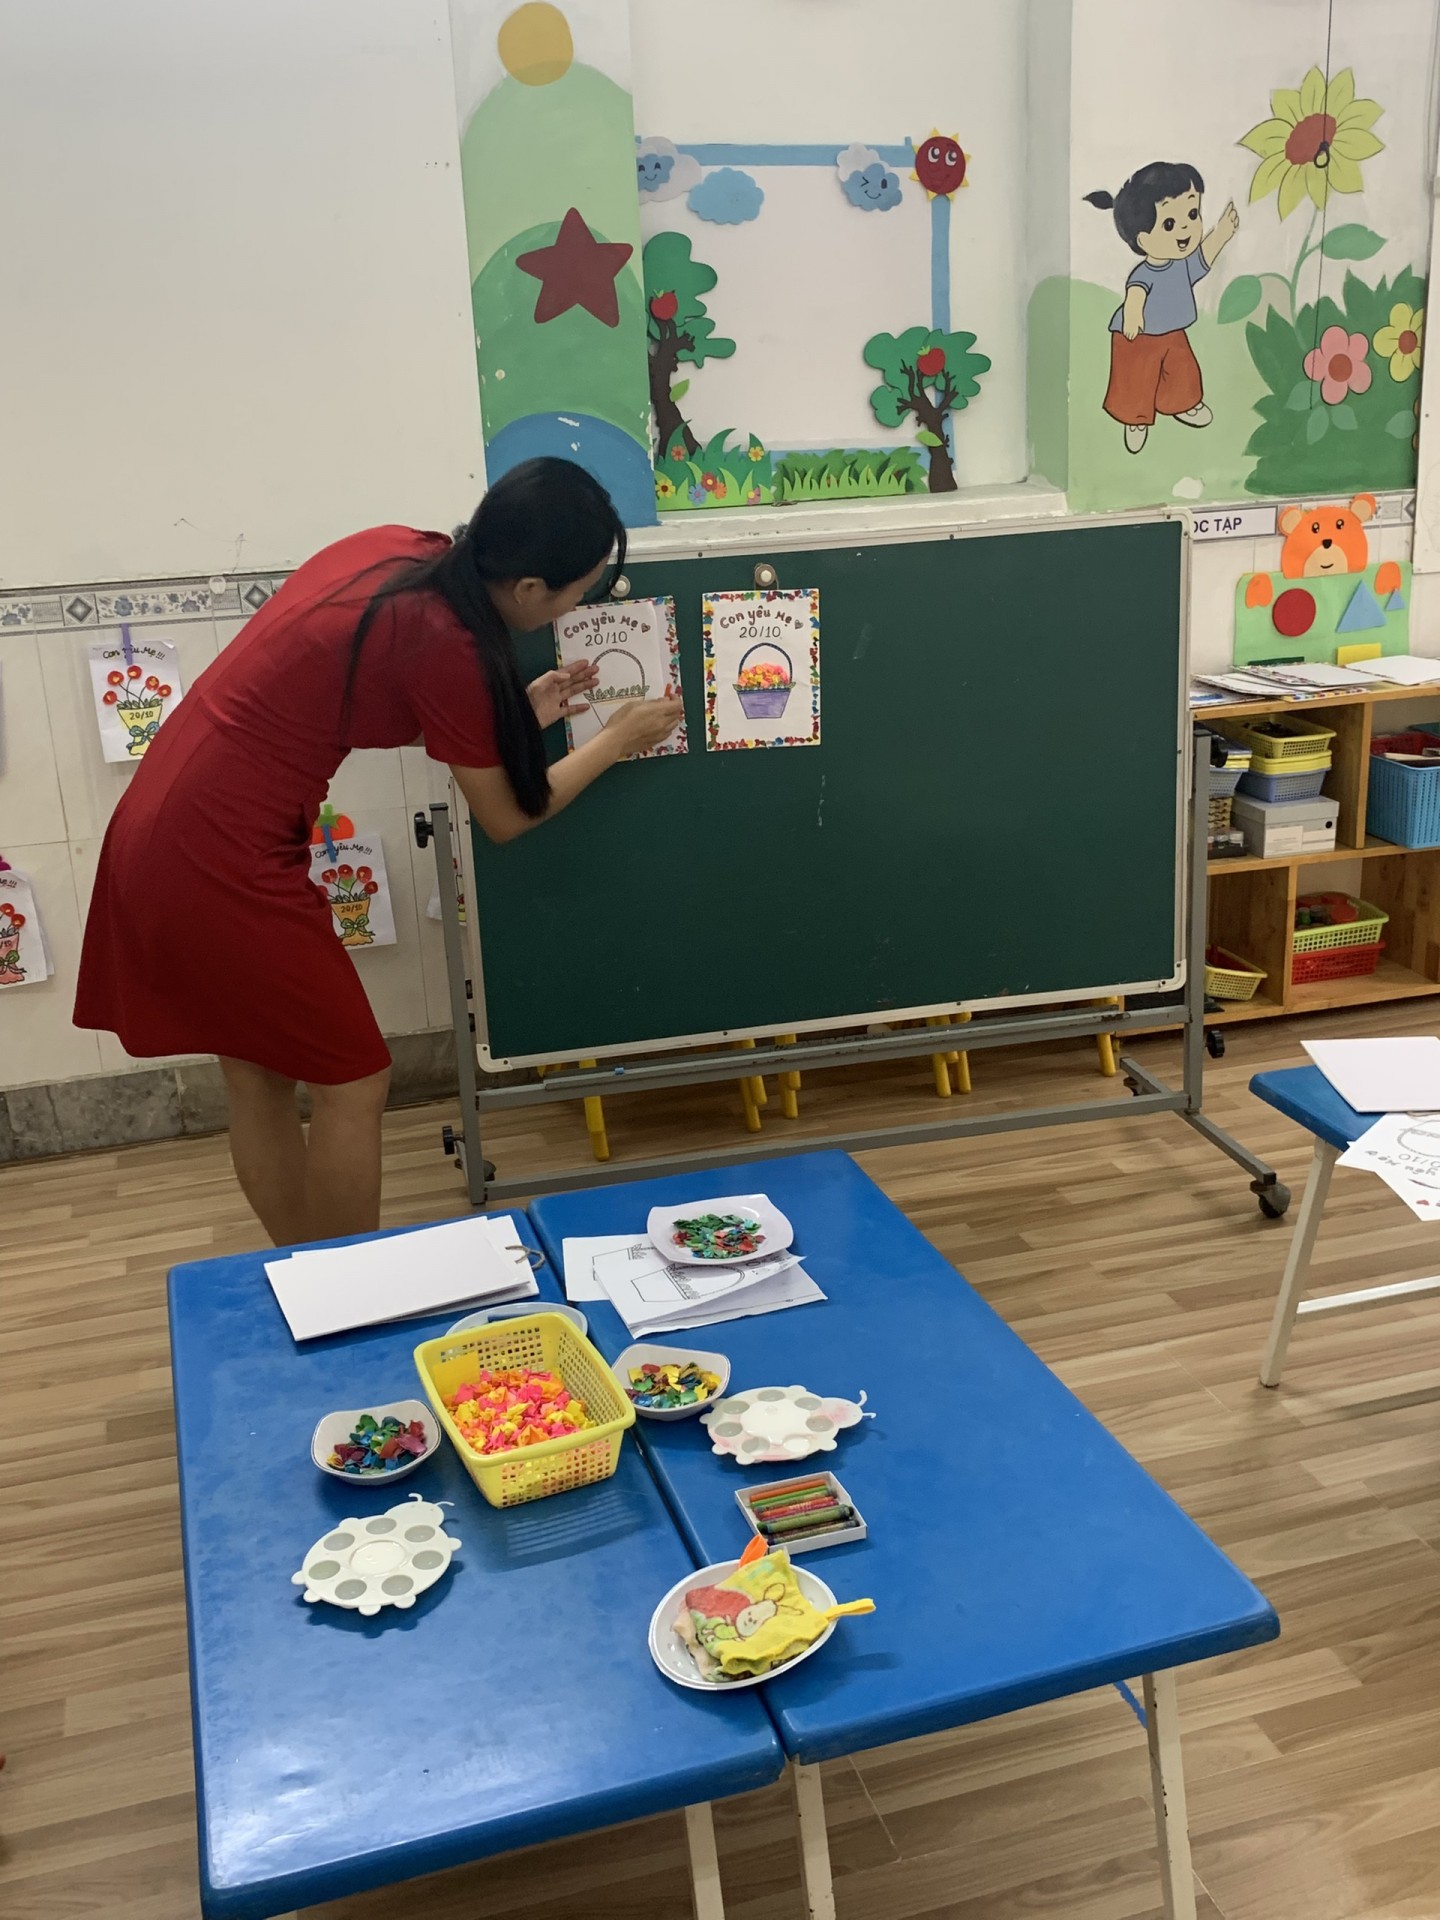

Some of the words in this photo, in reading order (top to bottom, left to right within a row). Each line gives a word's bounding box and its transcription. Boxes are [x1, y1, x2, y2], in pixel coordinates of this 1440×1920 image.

[1214, 517, 1242, 534] TẬP
[720, 612, 745, 629] Con
[748, 605, 771, 626] yêu
[775, 611, 793, 627] Mẹ
[563, 621, 589, 639] Con
[591, 611, 615, 633] yêu
[620, 615, 639, 631] Mẹ
[739, 626, 781, 638] 20/10
[585, 631, 628, 647] 20/10
[103, 650, 120, 659] Con
[129, 711, 154, 720] 20/10
[341, 904, 363, 913] 20/10
